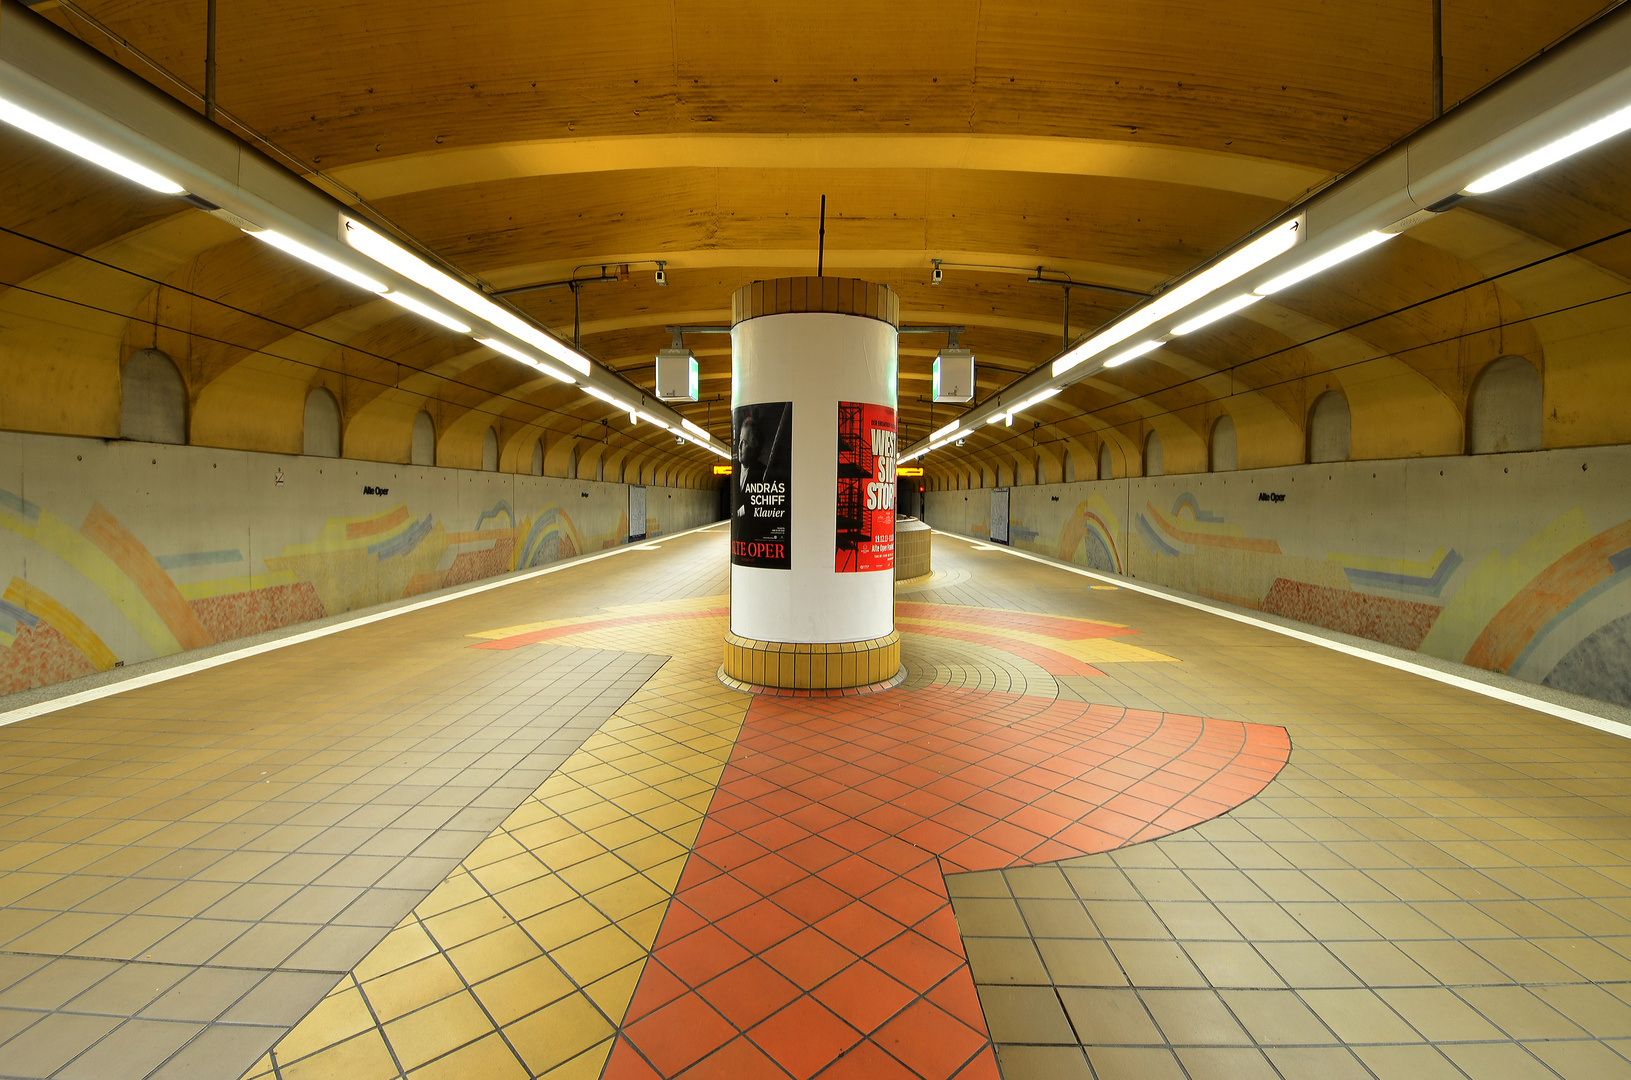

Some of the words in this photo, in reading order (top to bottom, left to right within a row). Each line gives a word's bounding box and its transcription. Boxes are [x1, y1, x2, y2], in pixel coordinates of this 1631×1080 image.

[878, 455, 895, 483] SID
[363, 486, 375, 495] Alte
[375, 486, 390, 497] Oper
[745, 480, 785, 494] ANDRÁS
[750, 495, 785, 505] SCHIFF
[867, 481, 895, 511] STOR
[1258, 492, 1270, 502] Alte
[1270, 492, 1286, 503] Oper
[753, 507, 786, 518] Klavier
[748, 542, 785, 559] OPER
